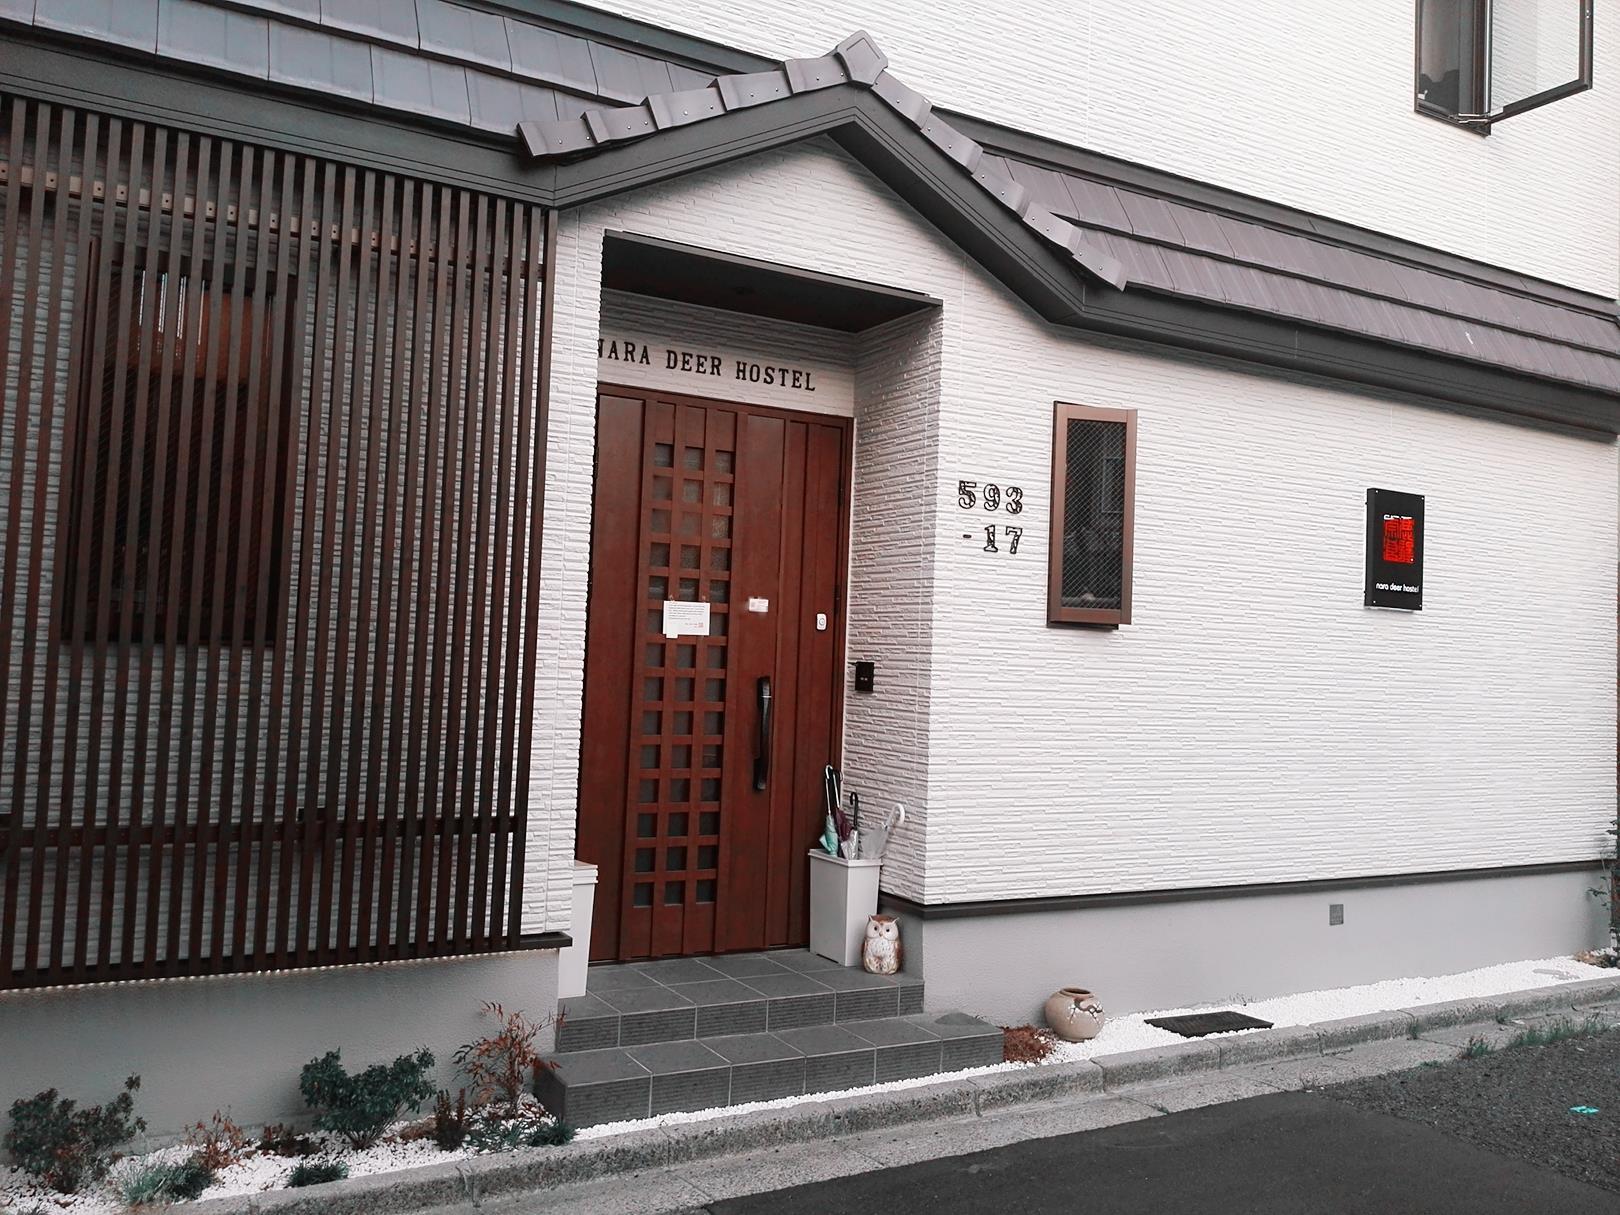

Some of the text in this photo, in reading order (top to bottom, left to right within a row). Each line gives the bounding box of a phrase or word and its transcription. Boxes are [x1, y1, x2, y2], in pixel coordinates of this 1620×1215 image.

[666, 349, 722, 376] DEER
[735, 360, 816, 392] HOSTEL
[958, 479, 1023, 515] 593
